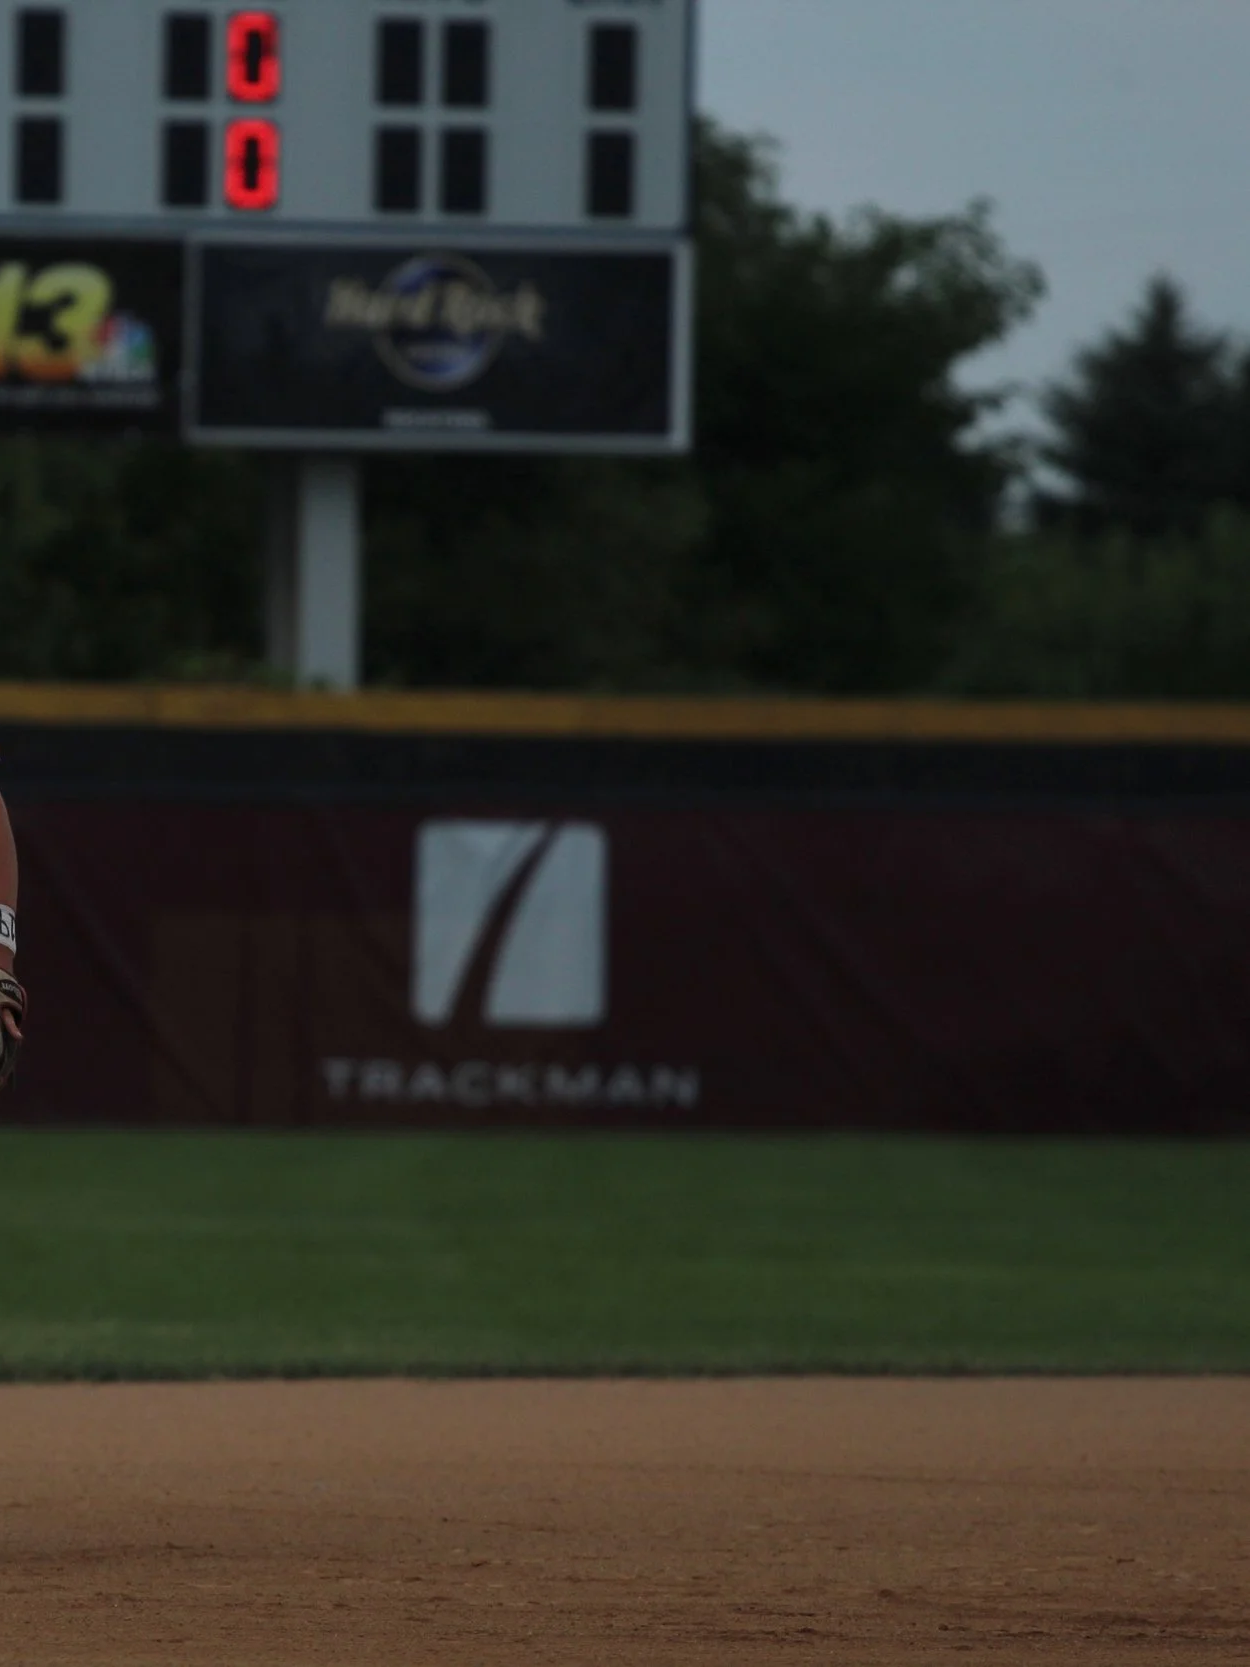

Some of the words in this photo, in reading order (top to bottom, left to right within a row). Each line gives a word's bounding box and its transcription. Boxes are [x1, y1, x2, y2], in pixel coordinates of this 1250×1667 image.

[226, 10, 279, 103] 0
[225, 118, 279, 211] 0
[321, 1056, 702, 1110] TRACKMAN
